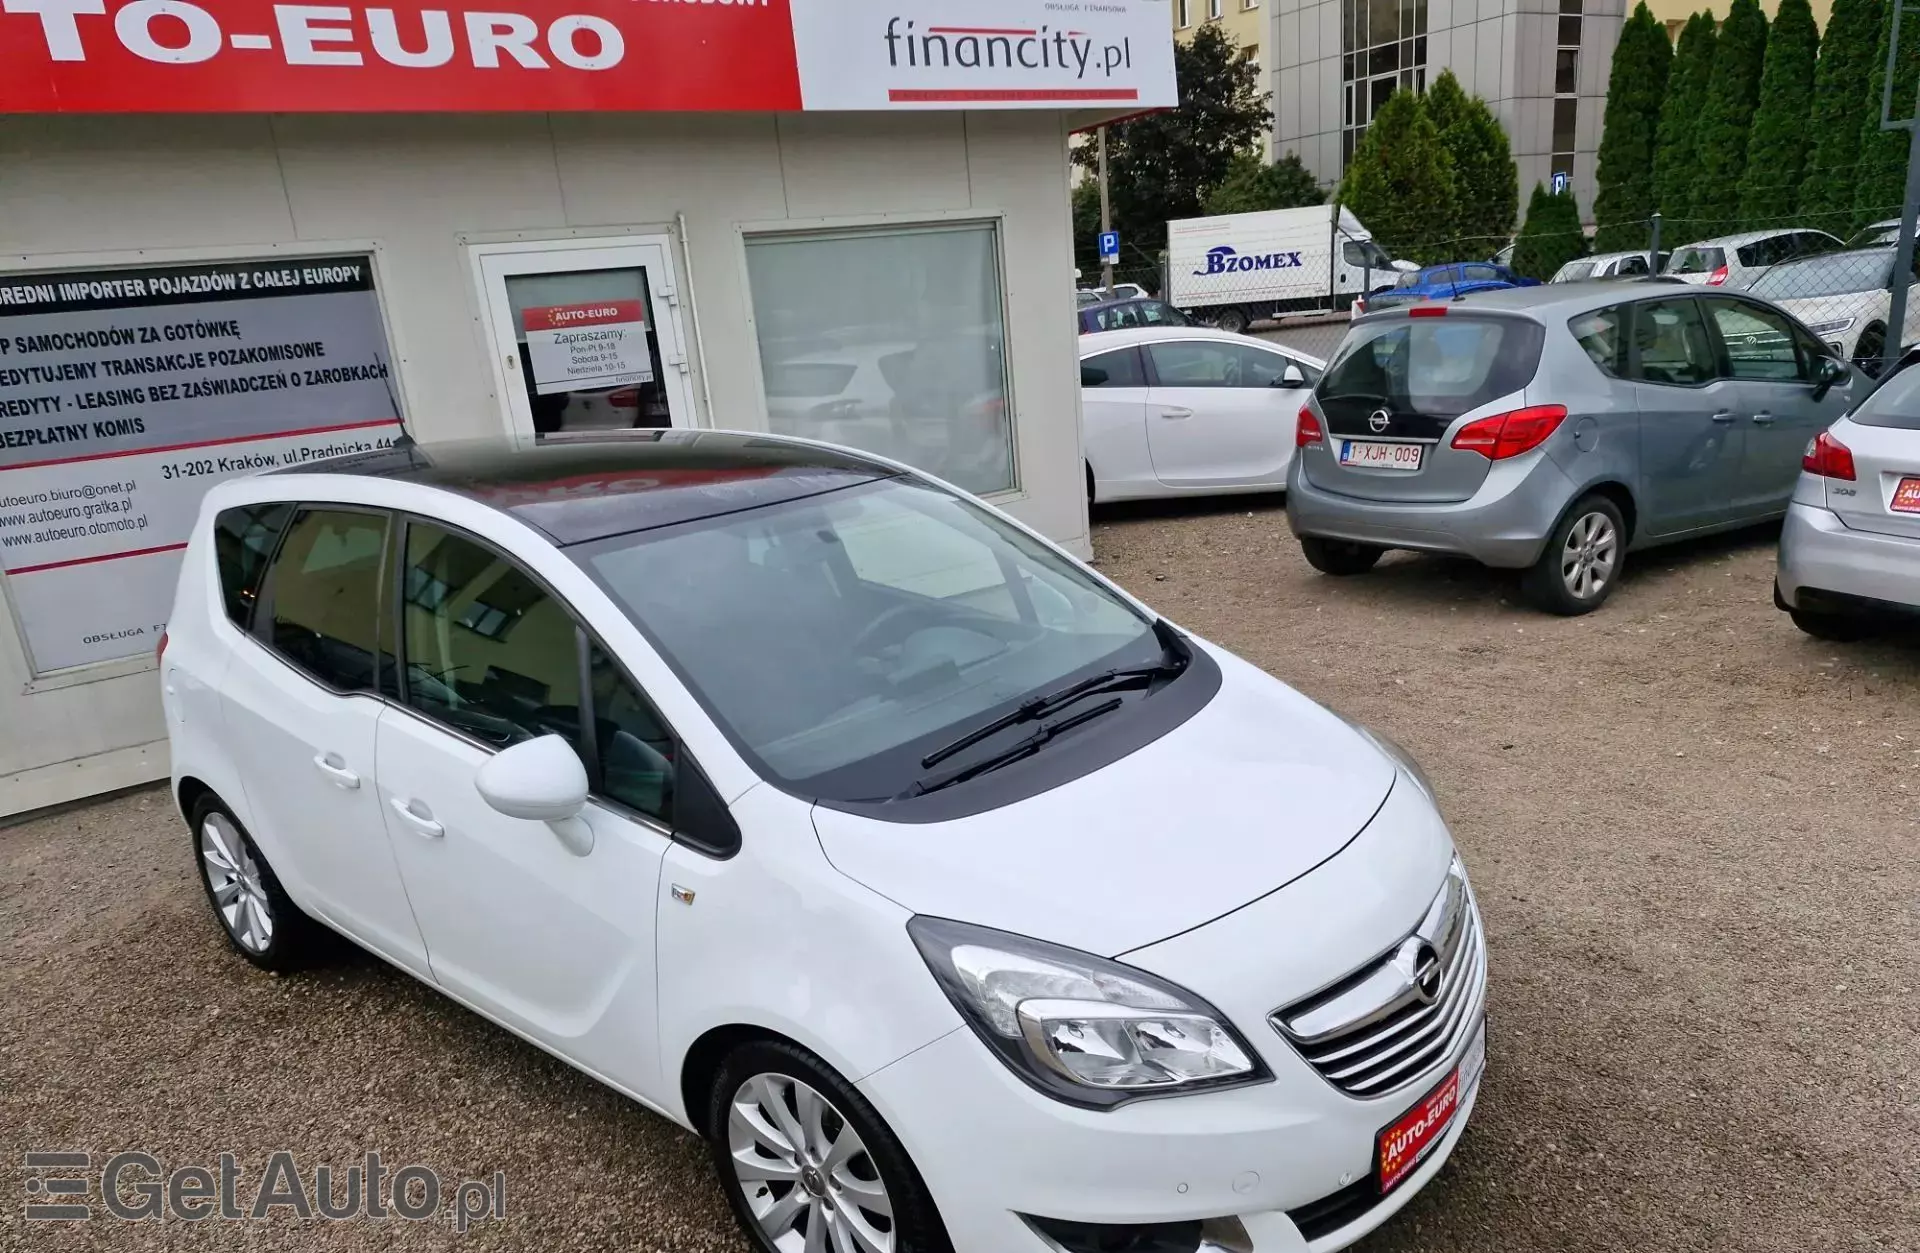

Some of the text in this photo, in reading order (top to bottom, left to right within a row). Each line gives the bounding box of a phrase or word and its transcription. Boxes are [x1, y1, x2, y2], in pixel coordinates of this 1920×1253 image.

[884, 16, 1131, 79] financity.pl
[1103, 234, 1115, 253] P
[1193, 249, 1302, 275] BZOMEX
[58, 279, 147, 301] IMPORTER
[149, 270, 236, 295] POJAZDÓW
[238, 272, 251, 289] Z
[253, 270, 300, 288] CAŁEJ
[303, 265, 361, 285] EUROPY
[555, 307, 618, 321] AUTO-EURO
[15, 325, 135, 354] SAMOCHODÓW
[138, 327, 161, 344] ZA
[163, 318, 242, 342] GOTÓWKĘ
[552, 328, 628, 345] Zapraszamy:
[101, 352, 206, 377] TRANSAKCJE
[208, 341, 326, 368] POZAKOMISOWE
[567, 362, 626, 375] Niedziela 10-15
[571, 352, 618, 364] Sobota 9-15
[75, 387, 145, 410] LEASING
[148, 384, 180, 402] BEZ
[181, 368, 287, 399] ZAŚWIADCZEŃ
[290, 371, 301, 387] O
[304, 363, 389, 386] ZAROBKACH
[92, 417, 145, 439] KOMIS
[161, 459, 215, 479] 31-202
[217, 452, 279, 474] Kraków,
[2, 514, 148, 547] www.autoeuro.otomoto.pl
[82, 627, 144, 644] OBSŁUGA
[1387, 1085, 1457, 1162] AUTO-EURO
